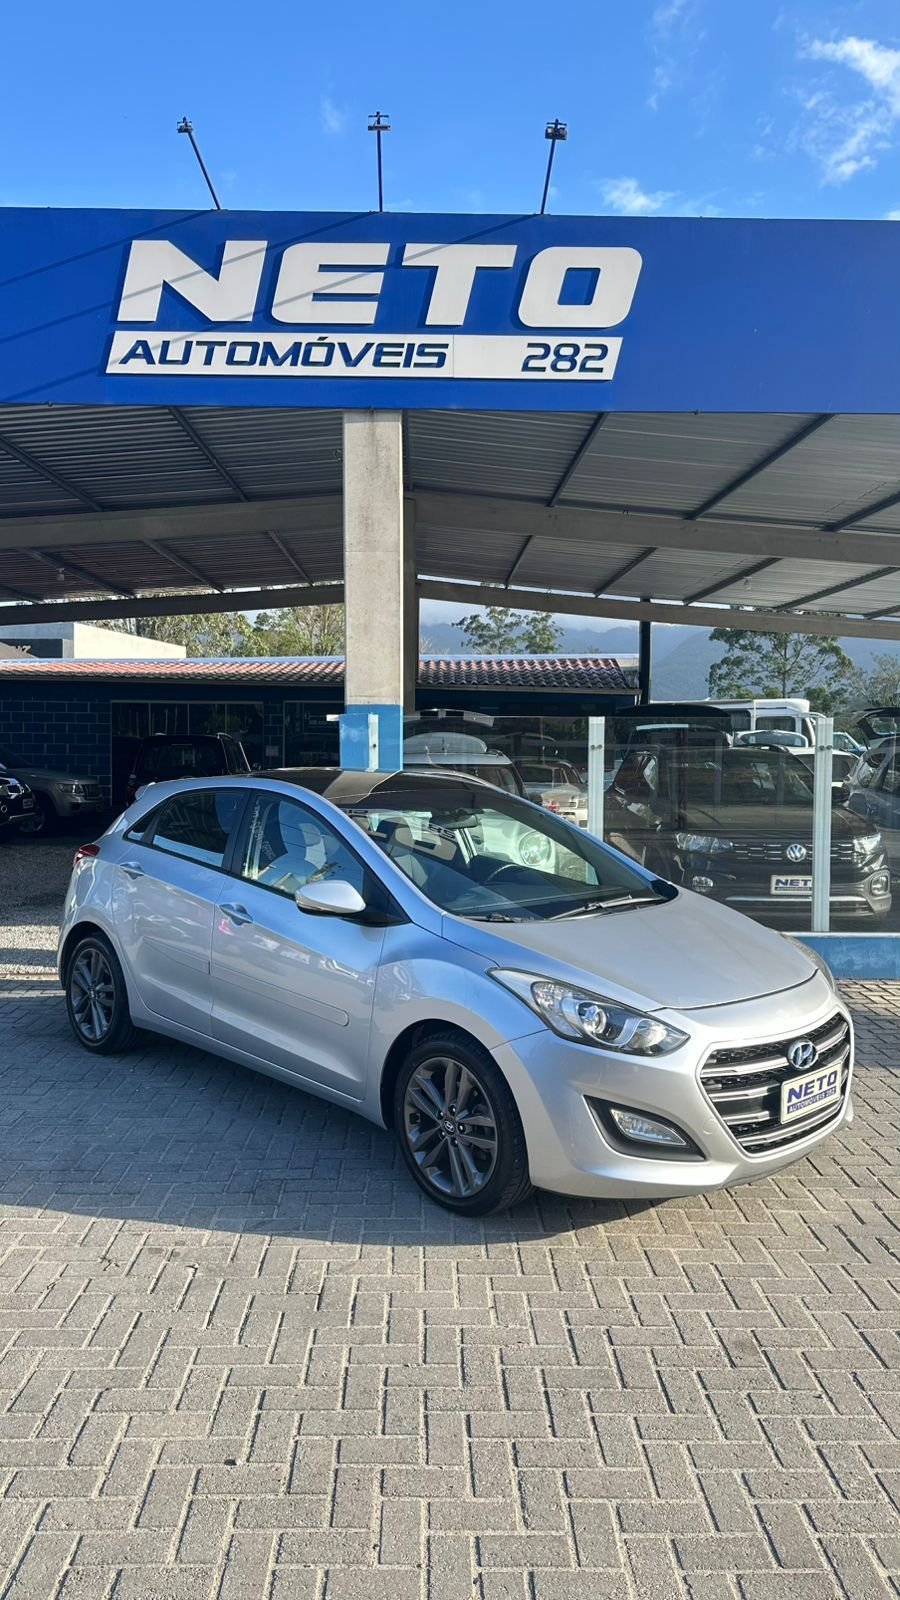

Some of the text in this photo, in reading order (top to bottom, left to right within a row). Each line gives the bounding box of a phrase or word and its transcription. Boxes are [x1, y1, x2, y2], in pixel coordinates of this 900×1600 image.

[116, 239, 643, 328] NETO
[118, 336, 609, 374] AUTOMÓVEIS 282
[775, 879, 812, 887] NET
[787, 1070, 838, 1104] NETO
